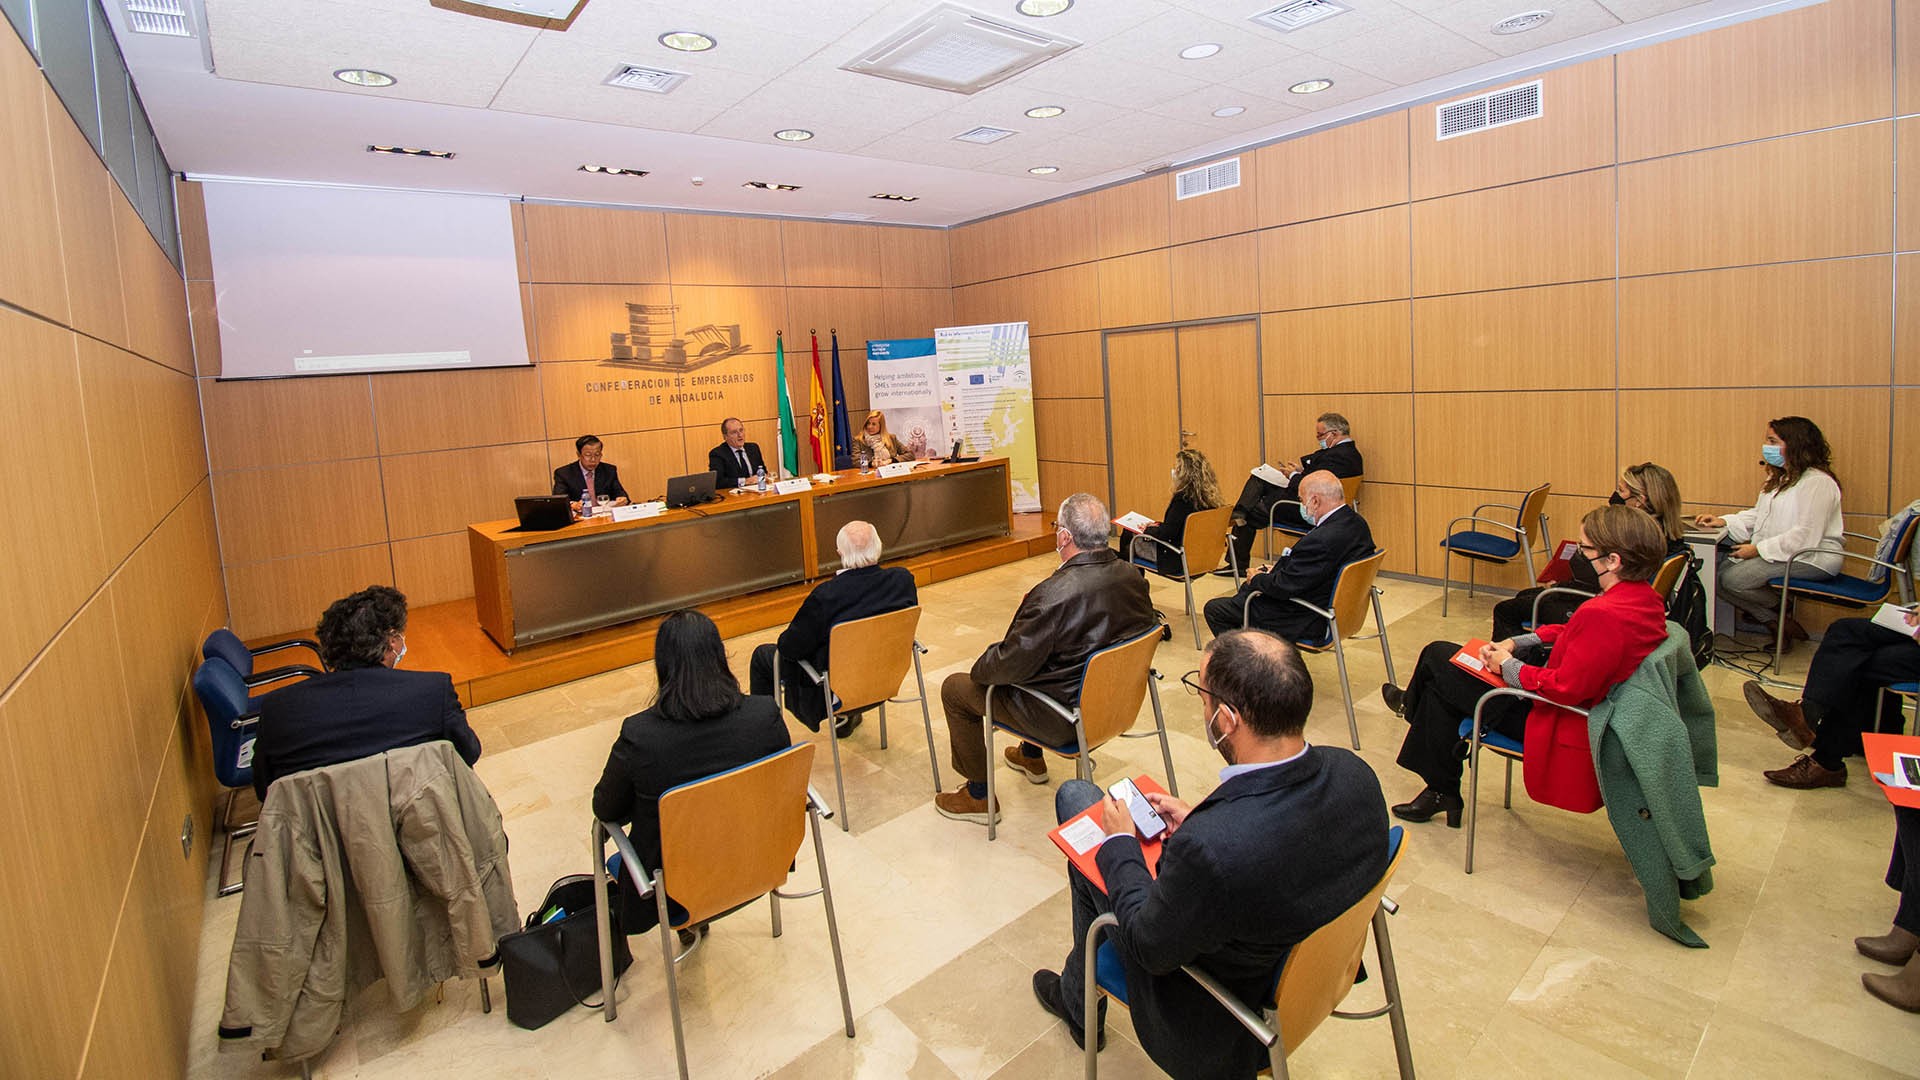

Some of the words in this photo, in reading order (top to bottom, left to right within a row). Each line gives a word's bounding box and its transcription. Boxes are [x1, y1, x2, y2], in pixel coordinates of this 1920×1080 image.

[586, 378, 670, 393] CONFEDERACION
[674, 377, 686, 387] DE
[691, 373, 754, 386] EMPRESARIOS
[874, 373, 896, 381] Helping
[649, 395, 662, 405] DE
[669, 391, 724, 404] ANDALUCIA
[875, 390, 889, 398] grow
[890, 388, 932, 397] internationally
